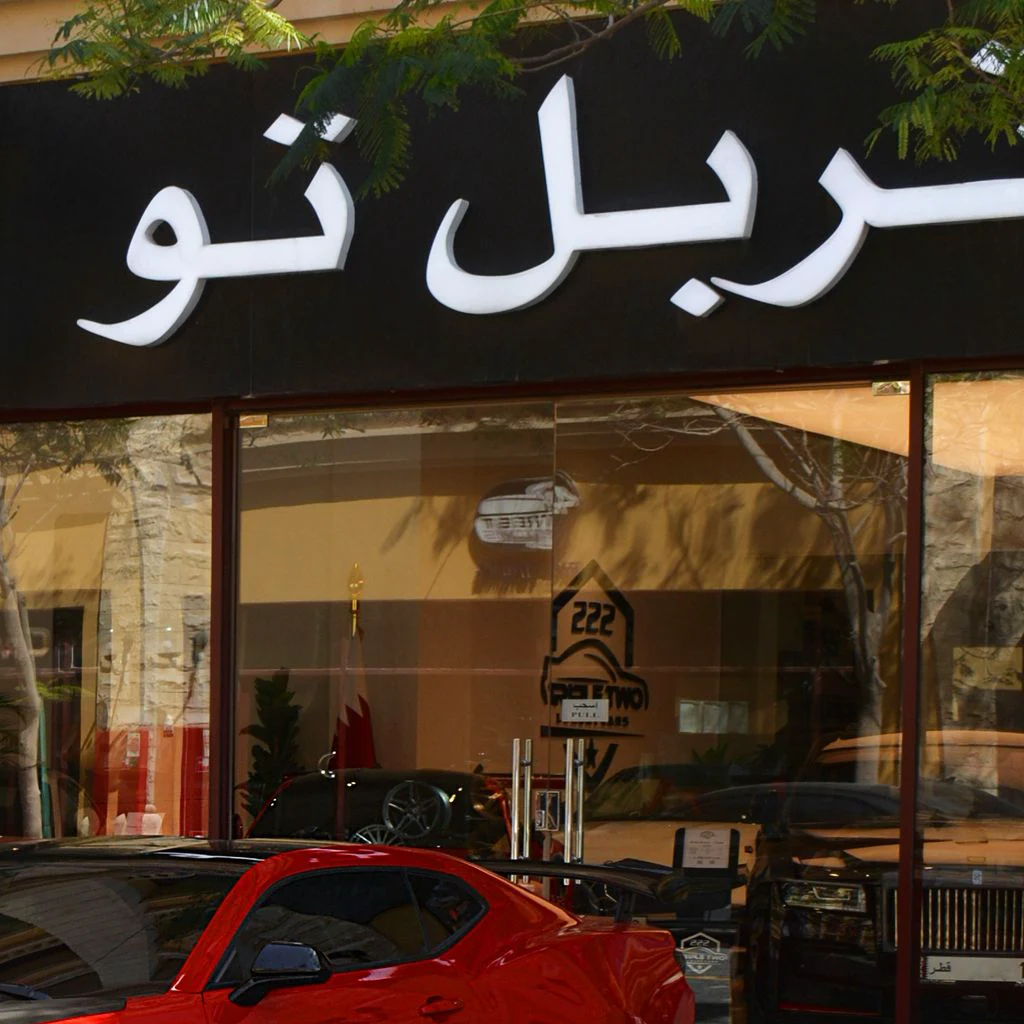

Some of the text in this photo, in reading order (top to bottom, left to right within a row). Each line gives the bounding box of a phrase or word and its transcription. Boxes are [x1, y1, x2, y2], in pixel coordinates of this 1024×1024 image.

[76, 112, 358, 347] تو
[571, 601, 616, 636] 222
[606, 686, 644, 710] TWO
